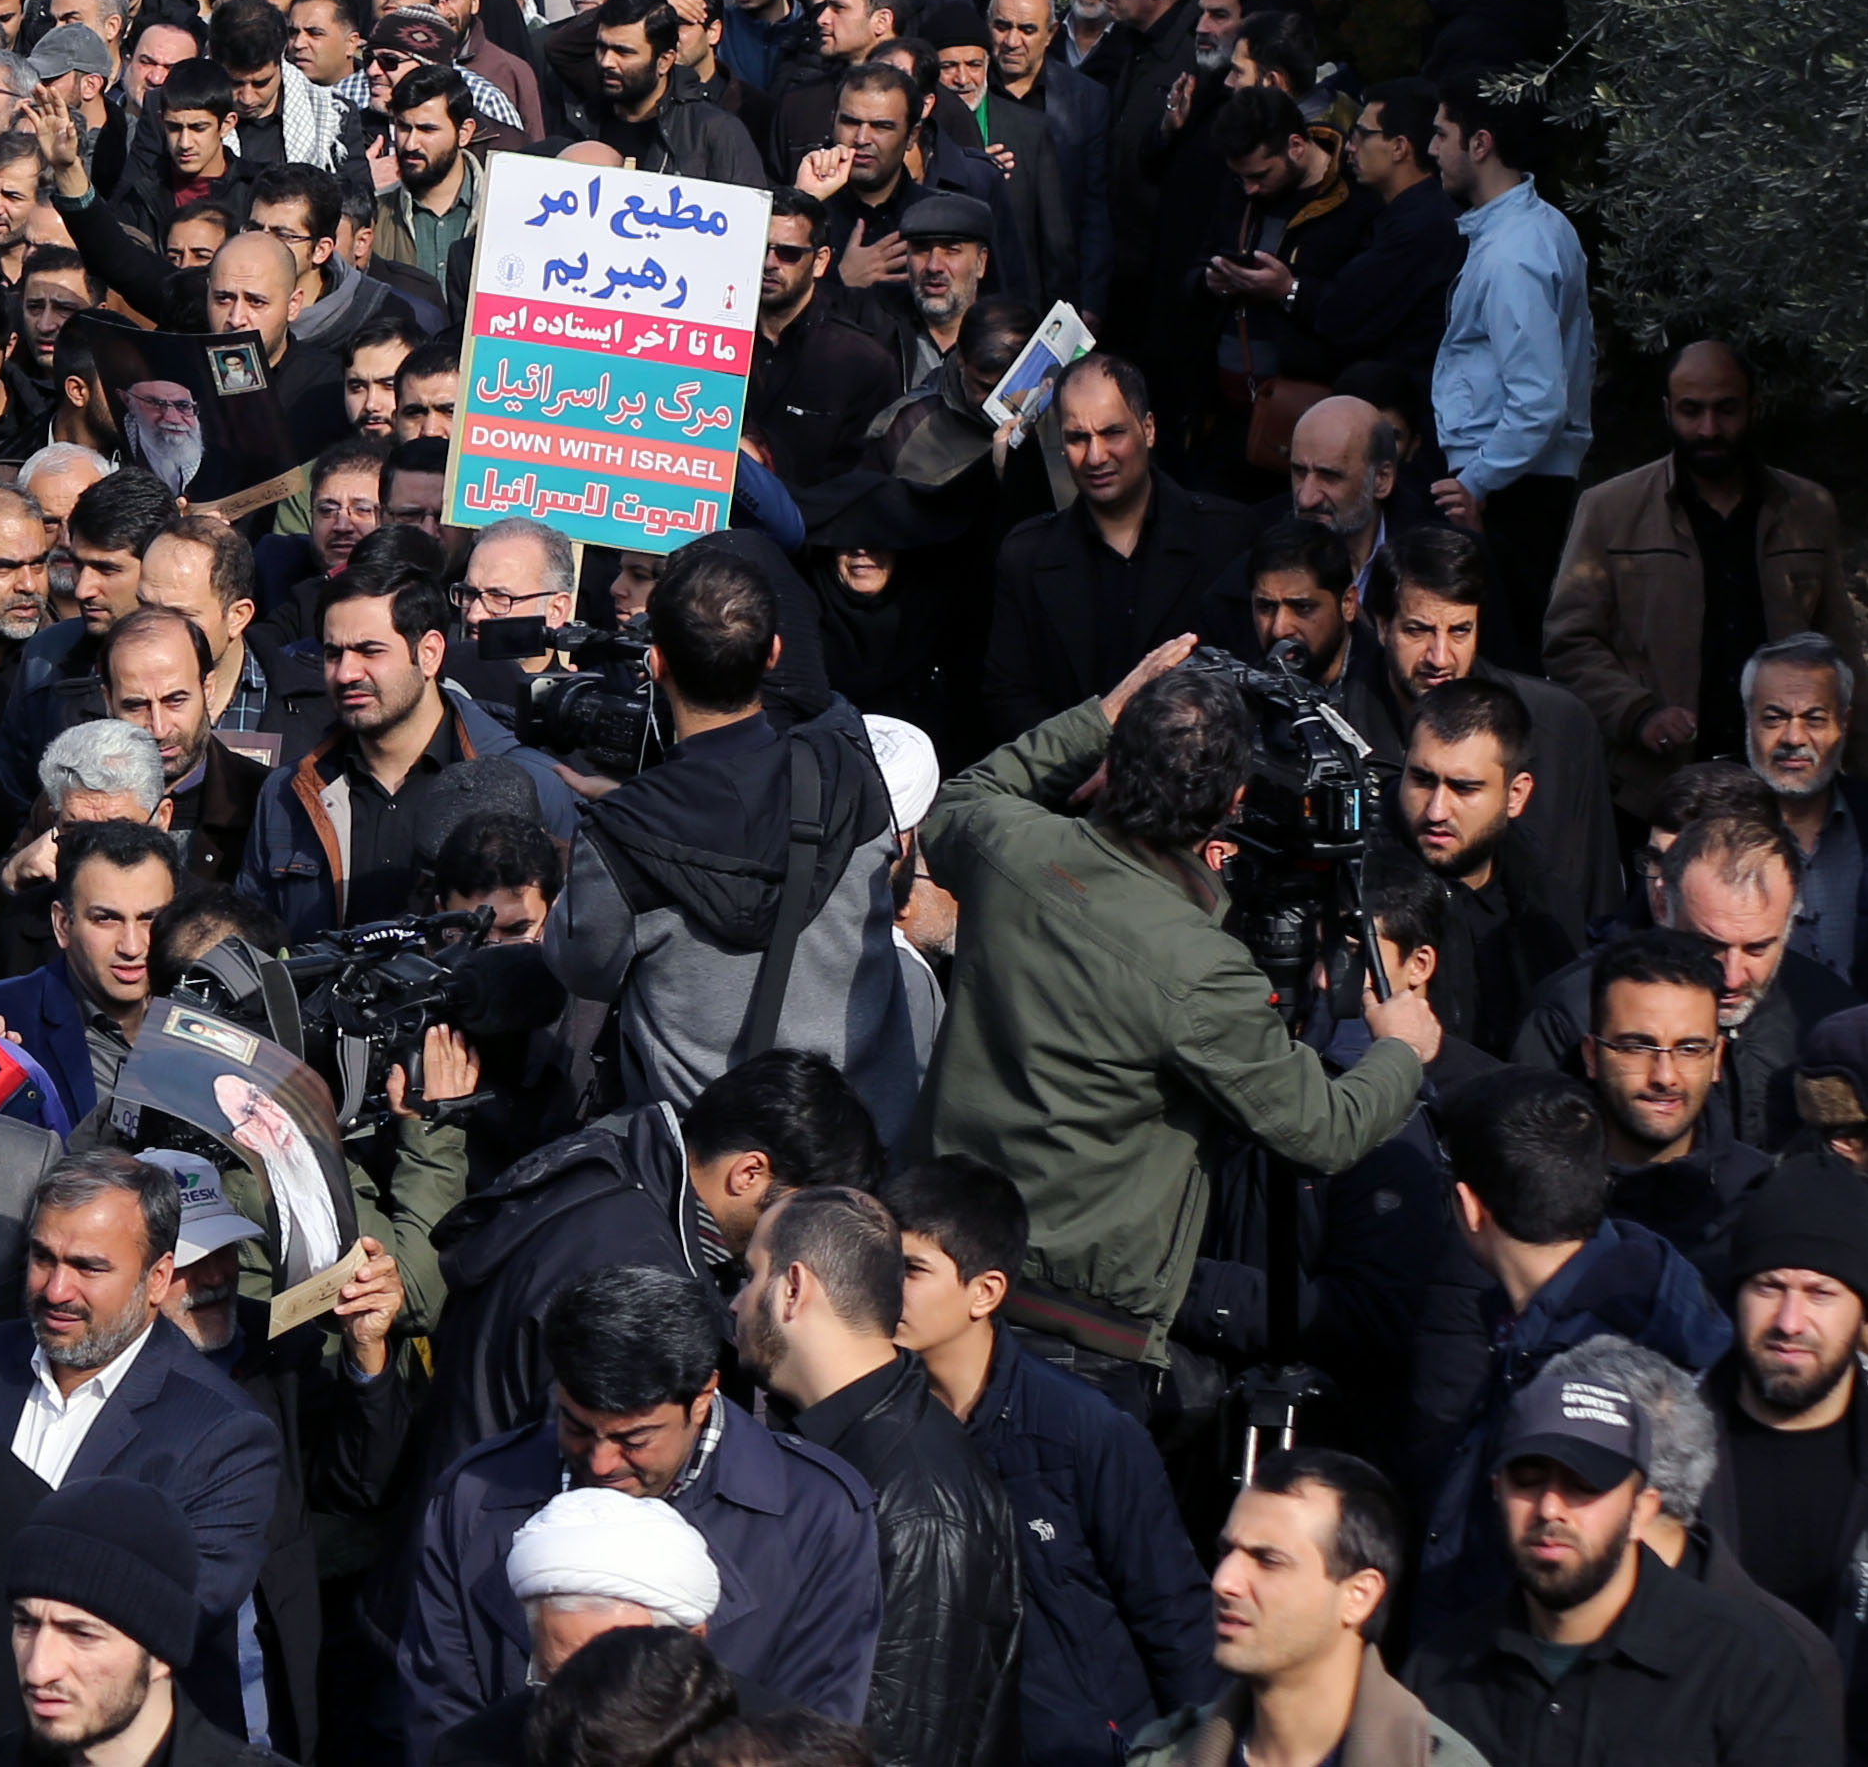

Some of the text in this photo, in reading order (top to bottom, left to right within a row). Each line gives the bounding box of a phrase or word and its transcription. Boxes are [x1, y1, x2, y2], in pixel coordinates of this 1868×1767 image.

[524, 174, 729, 240] مطیع امر
[542, 251, 688, 309] رهبریم
[488, 305, 736, 362] ما تا آخر ایستاده ایم
[475, 357, 734, 436] مرگ بر اسرائیل
[470, 425, 723, 482] DOWN WITH ISRAEL
[465, 467, 718, 535] الموت لاسرائیل
